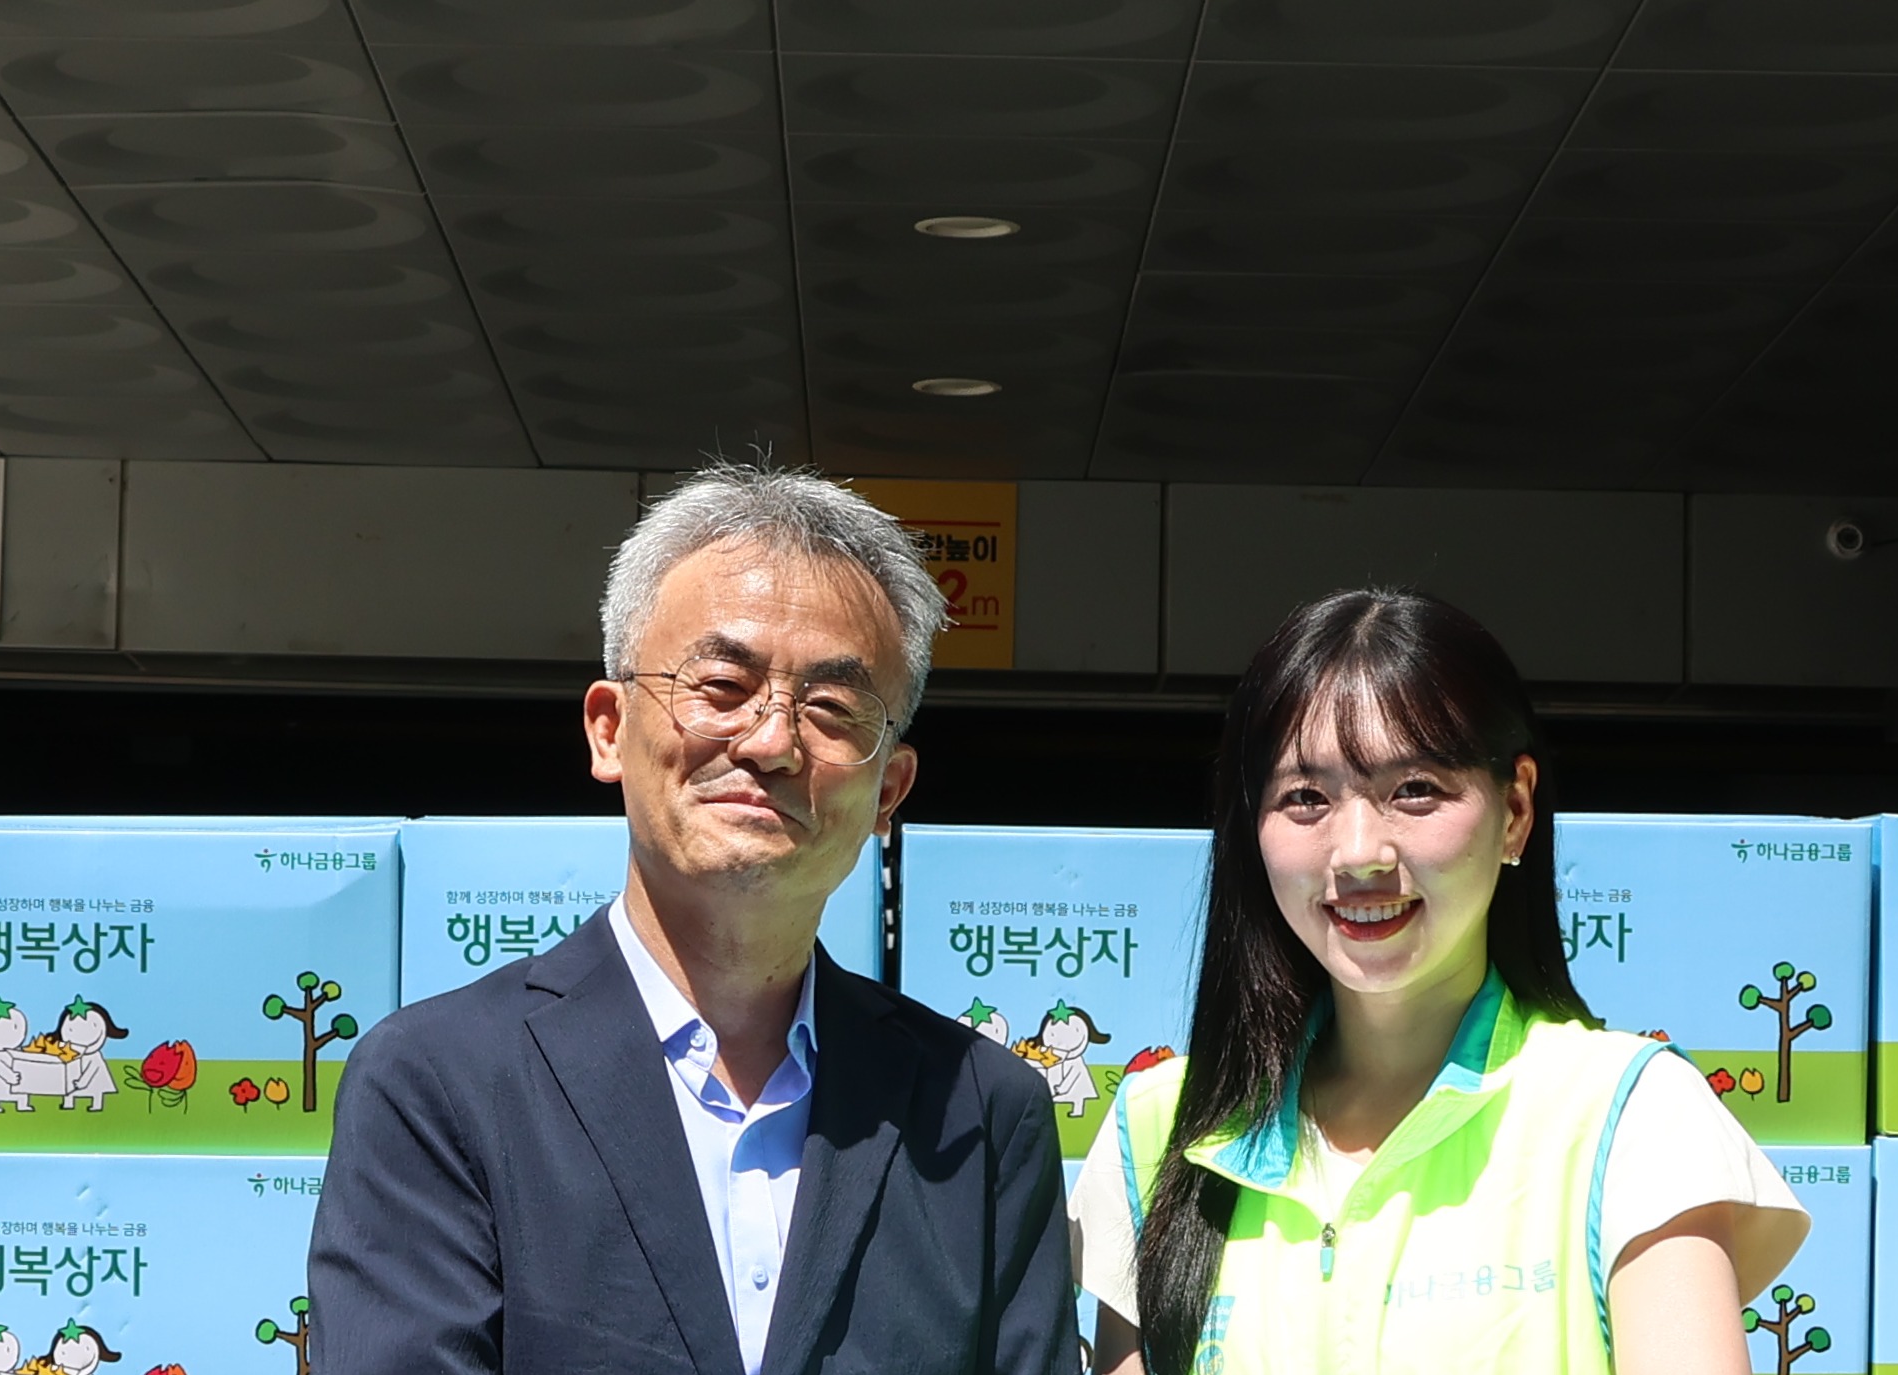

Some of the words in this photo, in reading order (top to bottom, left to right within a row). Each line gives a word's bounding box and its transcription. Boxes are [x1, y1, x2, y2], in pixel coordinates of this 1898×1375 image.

[279, 851, 377, 871] 하나금융그룹
[1756, 841, 1853, 862] 하나금융그룹
[949, 923, 1139, 979] 행복상자
